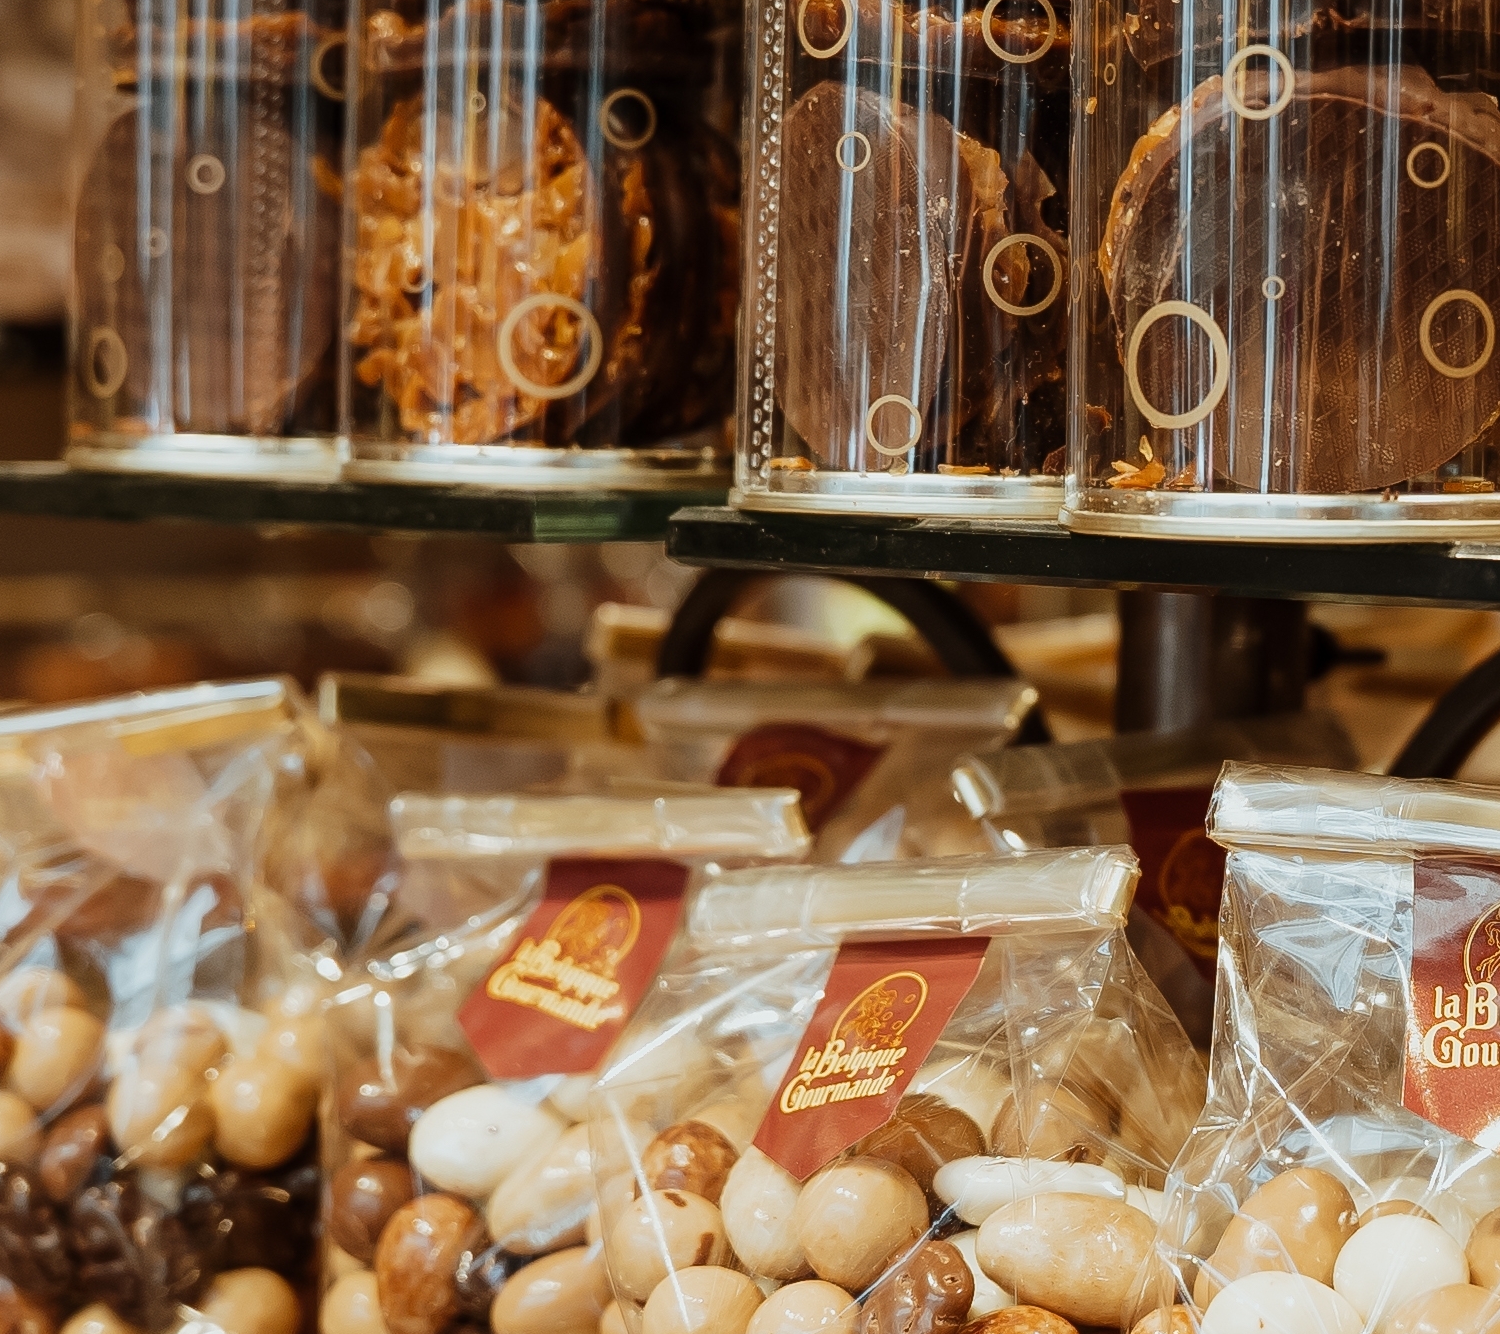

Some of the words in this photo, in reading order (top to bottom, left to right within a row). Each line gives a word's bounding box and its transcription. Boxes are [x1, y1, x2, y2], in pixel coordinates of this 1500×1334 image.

[1434, 986, 1462, 1019] la
[799, 1046, 823, 1072] la
[813, 1039, 908, 1078] Belgique
